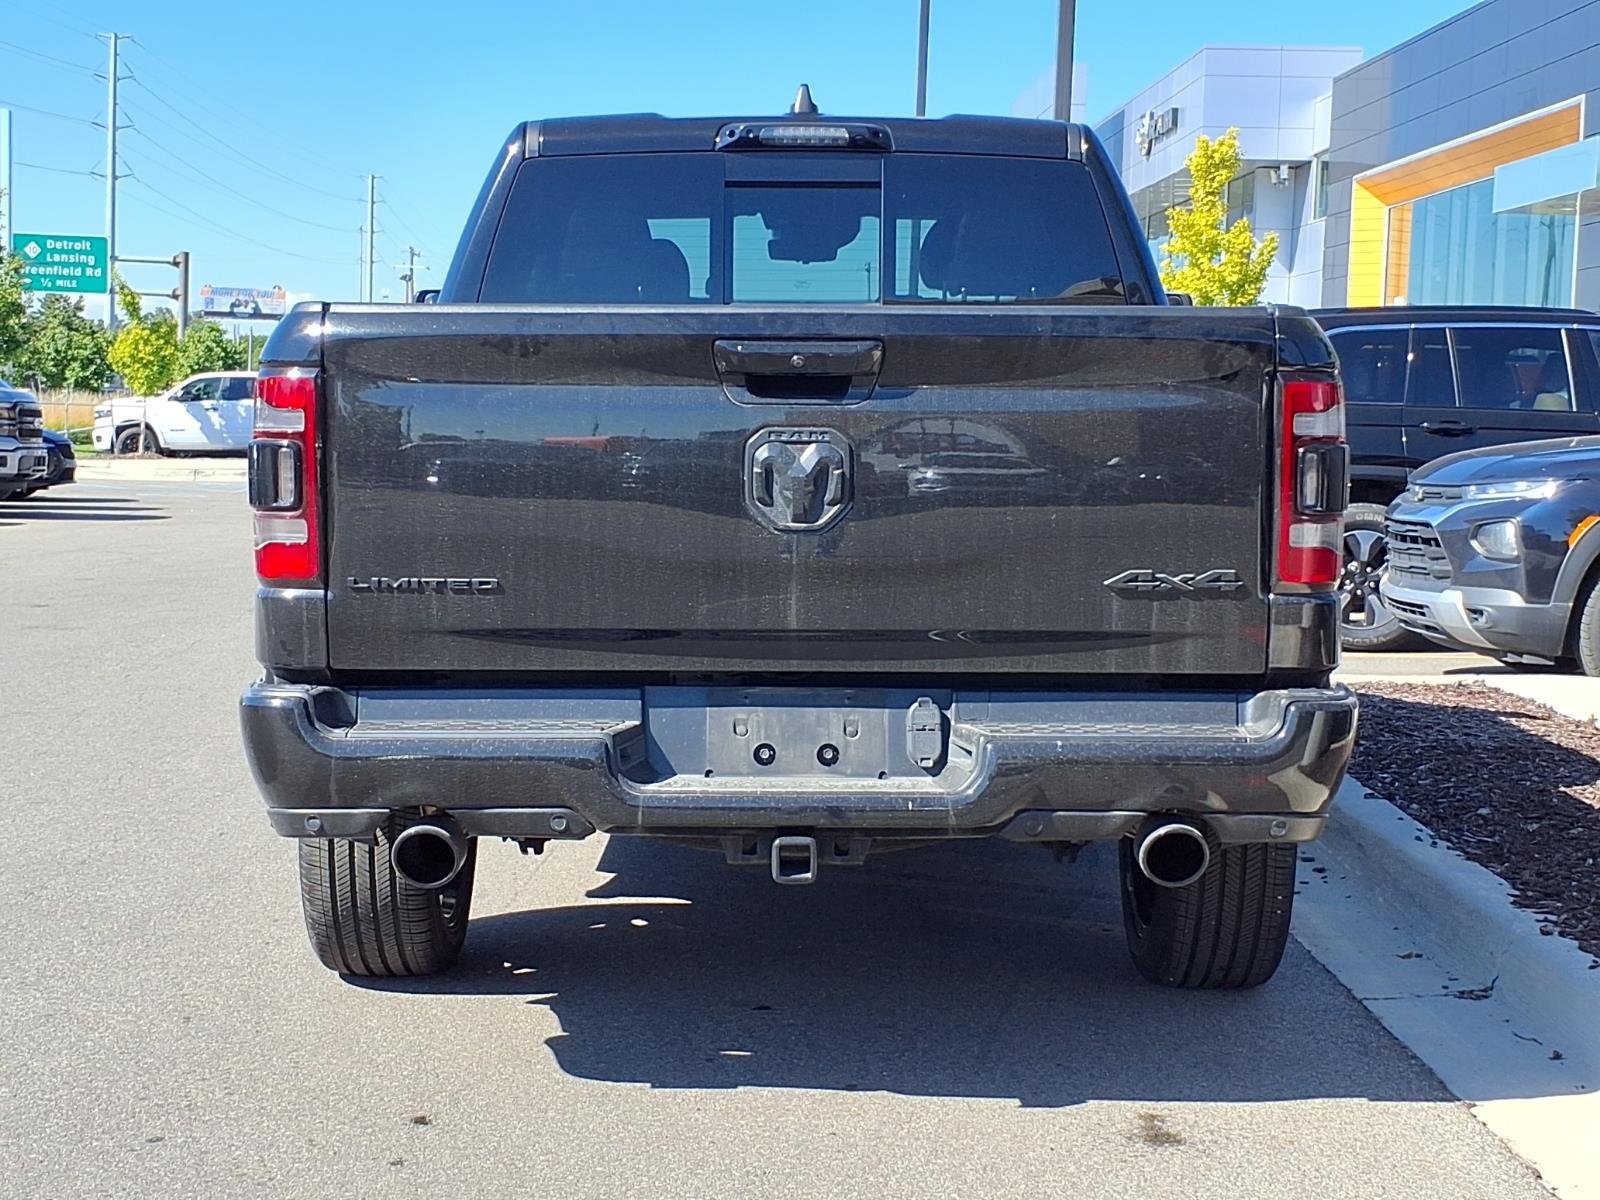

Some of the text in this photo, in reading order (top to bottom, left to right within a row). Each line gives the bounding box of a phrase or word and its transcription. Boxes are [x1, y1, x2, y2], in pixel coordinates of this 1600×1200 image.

[46, 239, 91, 250] Detroit
[46, 253, 95, 266] Lansing
[86, 267, 102, 277] Rd
[55, 279, 77, 287] MILE
[768, 431, 829, 440] RAM
[347, 577, 499, 590] LIMITED
